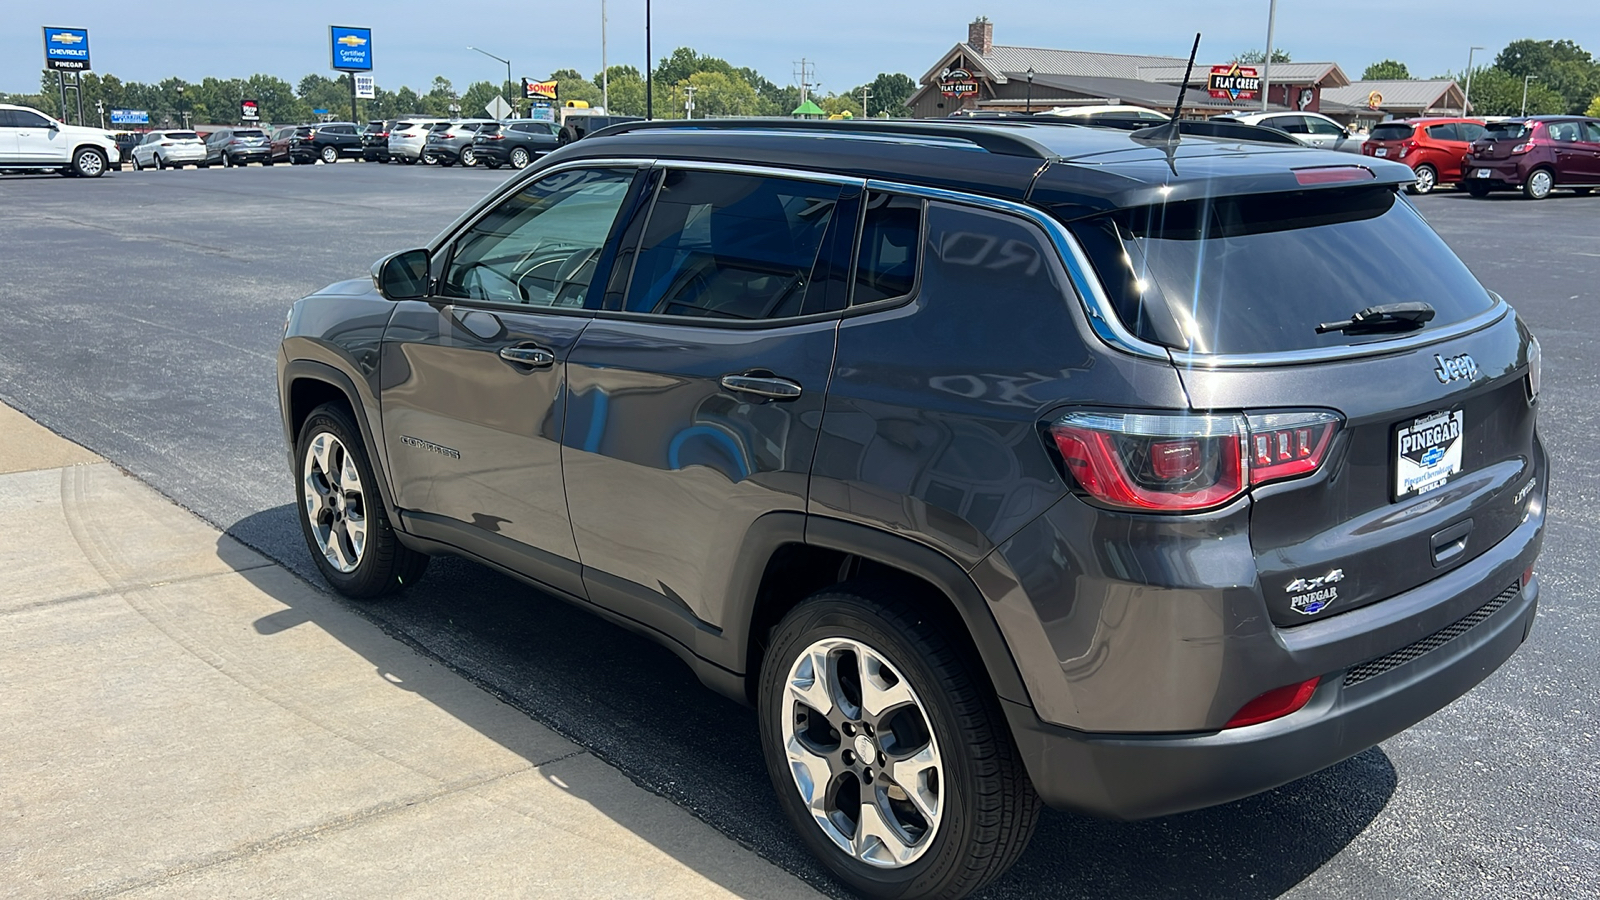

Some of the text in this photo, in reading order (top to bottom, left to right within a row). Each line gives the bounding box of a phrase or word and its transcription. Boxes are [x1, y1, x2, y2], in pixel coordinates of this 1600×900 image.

[49, 48, 87, 56] CHEVROLET
[340, 49, 366, 58] Certified
[357, 77, 373, 85] BODY
[1215, 77, 1260, 90] FLAT CREEK
[528, 84, 555, 93] SONIC
[941, 84, 973, 92] FLAT CREEK
[1433, 354, 1477, 383] Jeep
[1401, 421, 1459, 455] PINEGAR
[400, 435, 460, 459] COMPASS
[1285, 568, 1345, 592] 4x4
[1291, 586, 1338, 608] PINEGAR
